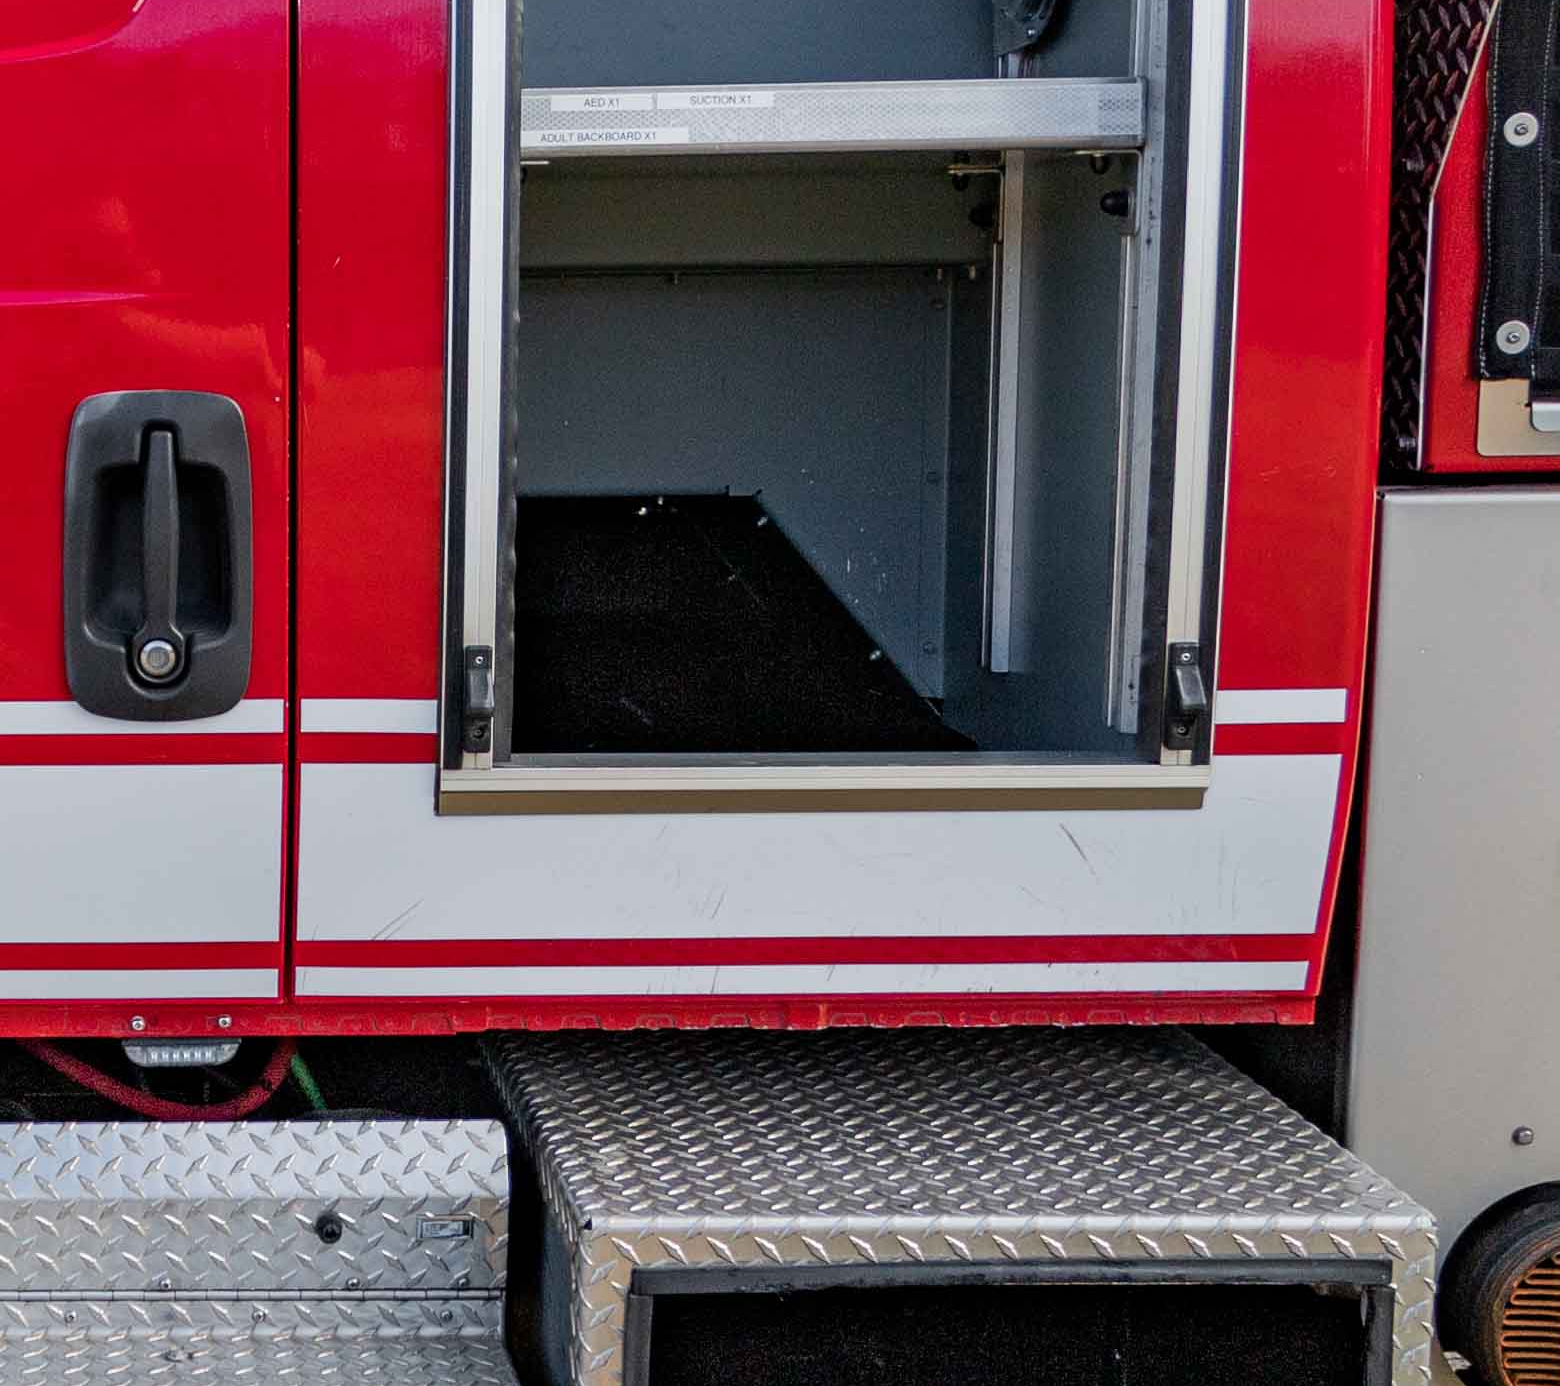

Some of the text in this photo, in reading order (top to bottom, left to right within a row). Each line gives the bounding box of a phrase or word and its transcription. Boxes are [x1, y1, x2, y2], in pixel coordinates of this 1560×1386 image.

[583, 97, 620, 108] AED X1
[689, 94, 752, 105] SUCTION X1
[540, 131, 657, 143] ADULT BACKBOARD X1
